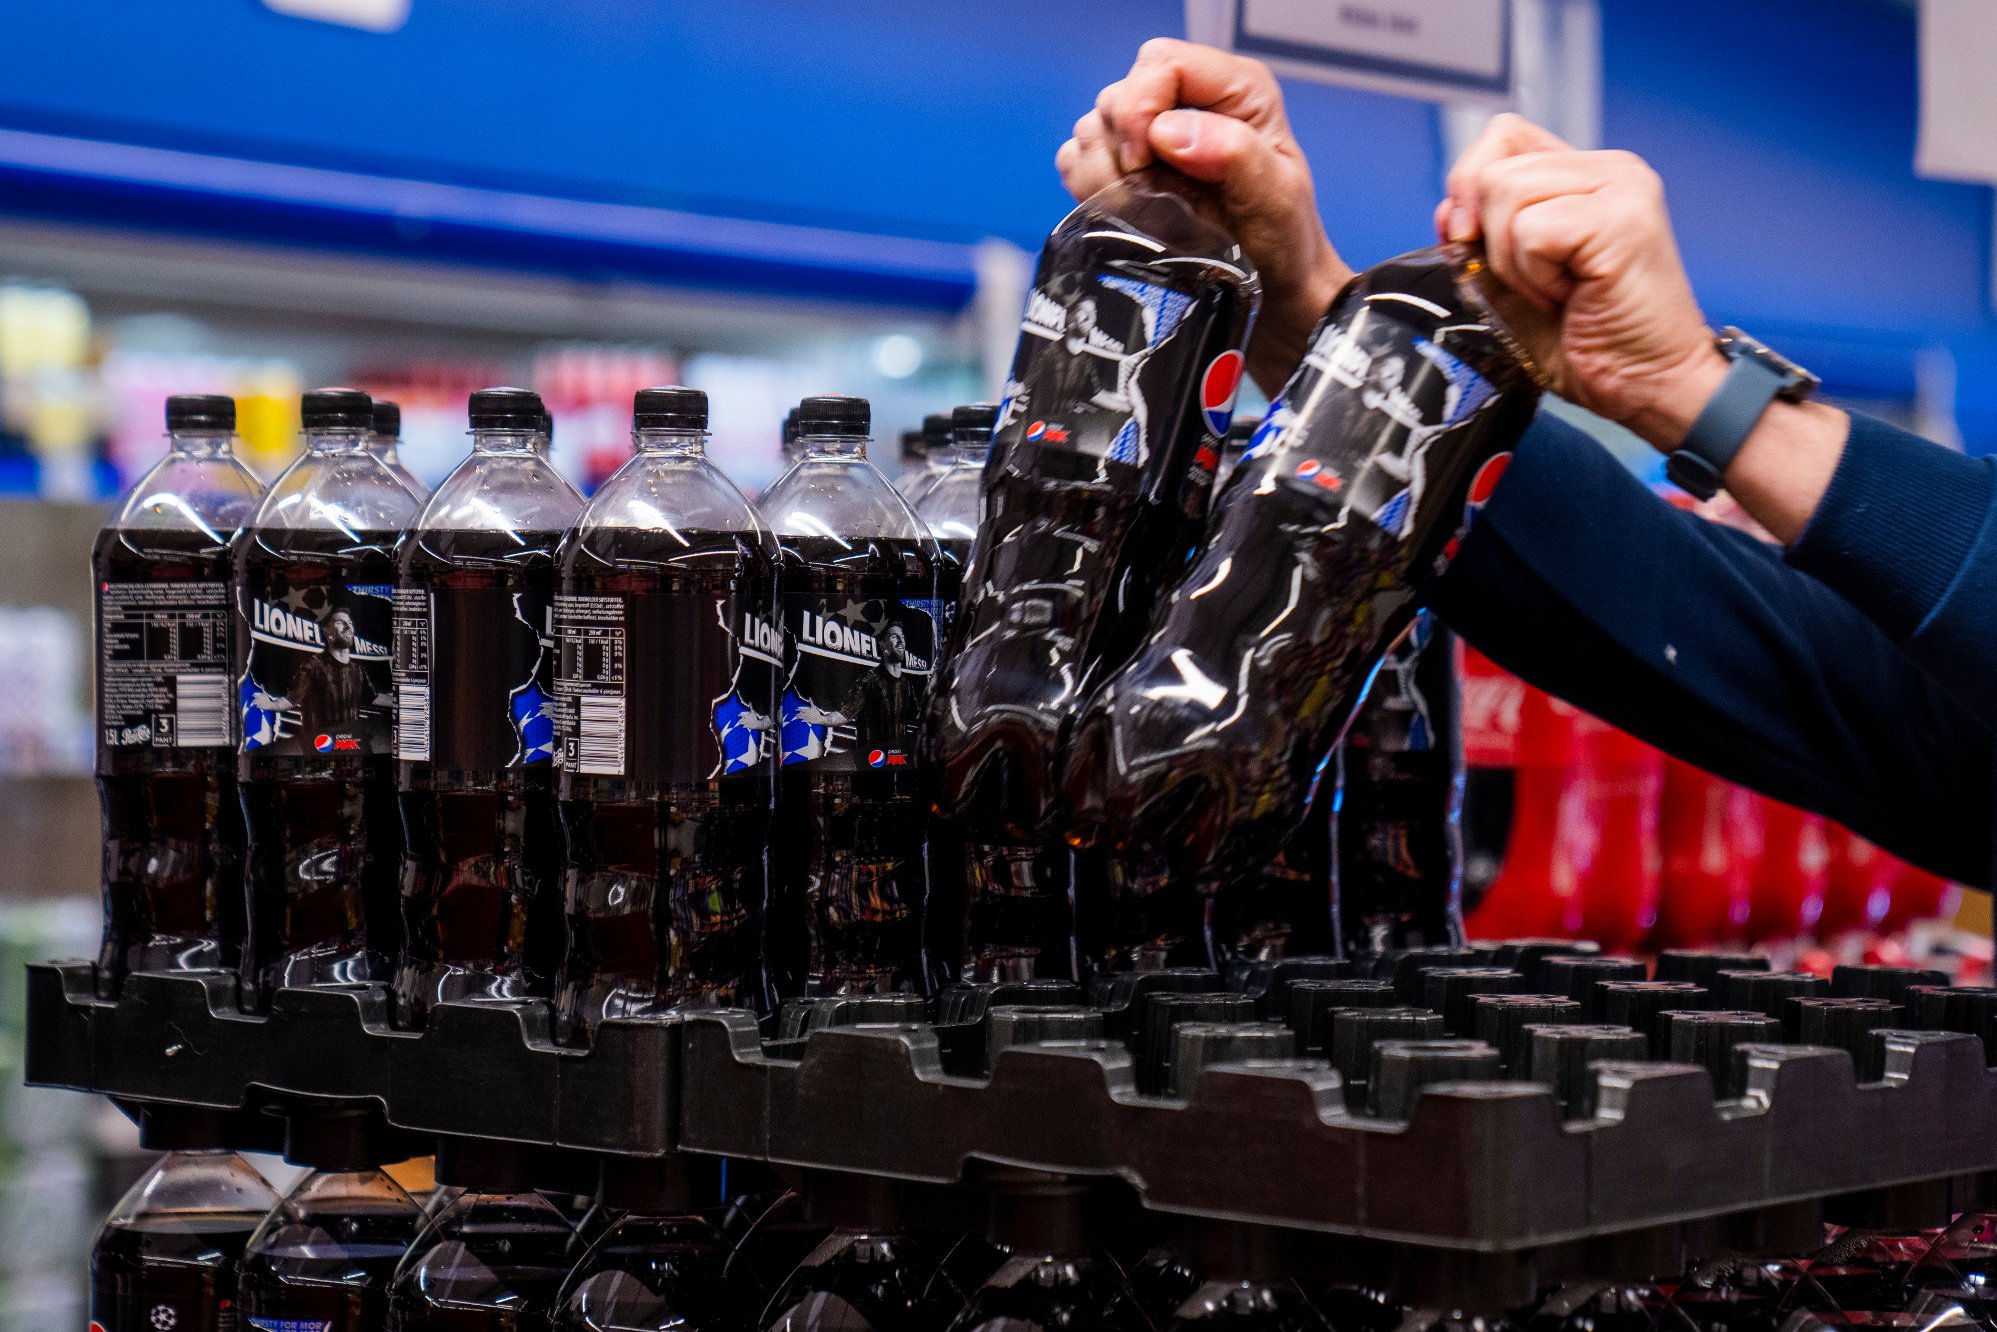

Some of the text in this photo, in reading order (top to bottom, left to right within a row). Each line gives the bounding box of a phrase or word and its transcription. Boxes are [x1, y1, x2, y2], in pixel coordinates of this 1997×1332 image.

[254, 598, 325, 646] LIONEL
[353, 635, 388, 655] MESSI
[802, 610, 882, 660] LIONEL
[904, 650, 928, 670] MESSI
[159, 718, 169, 733] 3
[568, 742, 575, 757] 3
[279, 1320, 297, 1330] FOR
